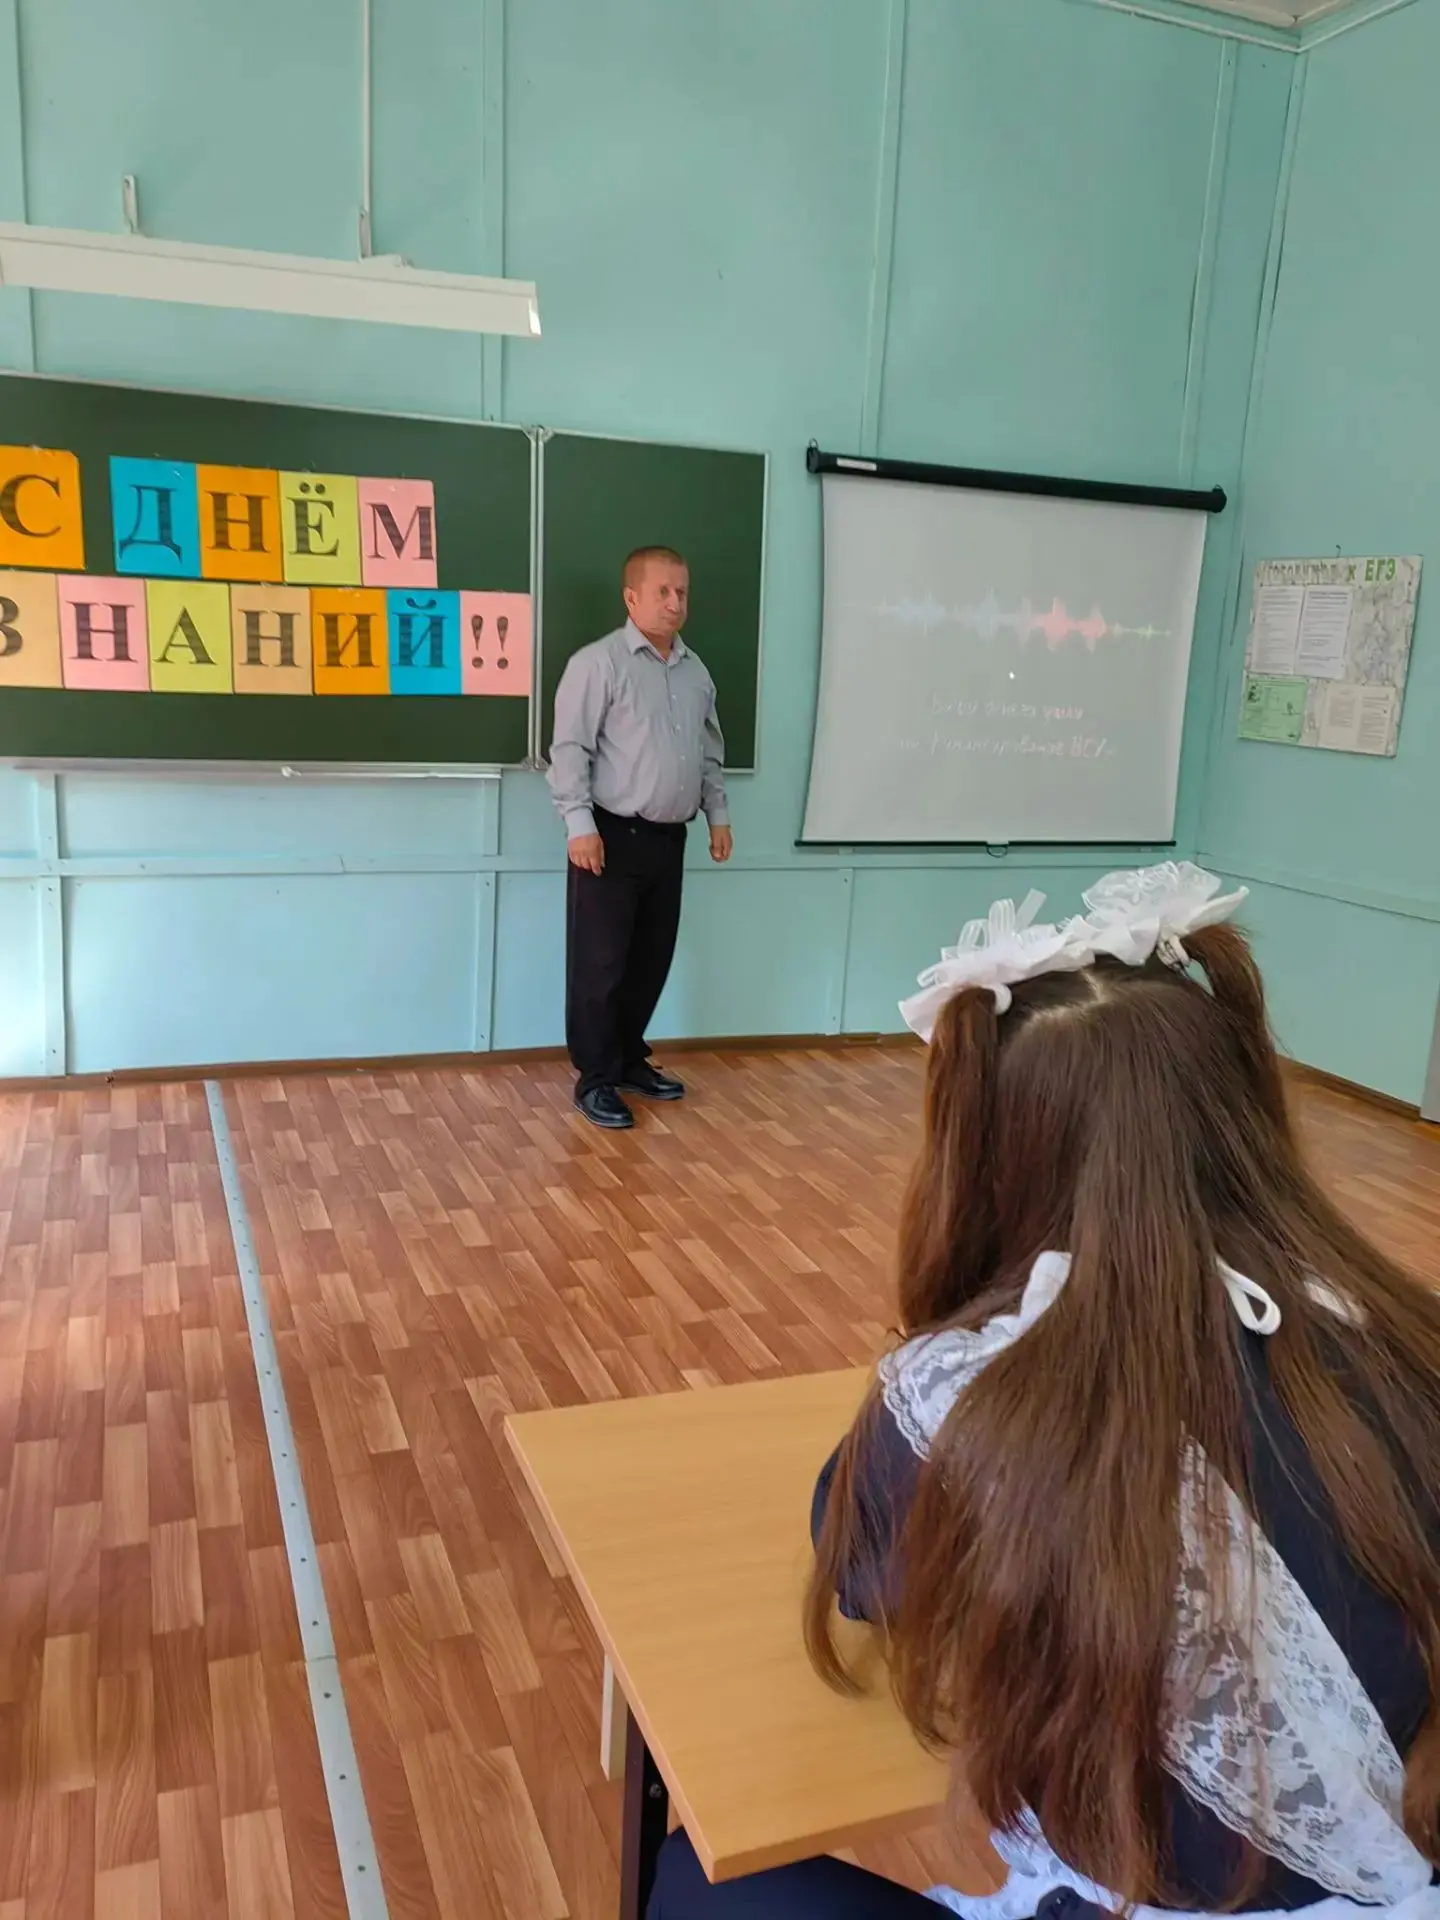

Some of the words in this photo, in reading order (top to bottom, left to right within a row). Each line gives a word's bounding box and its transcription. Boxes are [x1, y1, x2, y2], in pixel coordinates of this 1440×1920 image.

[0, 474, 61, 538] С
[118, 481, 435, 563] ДНЁМ
[1364, 558, 1396, 582] ЕГЭ
